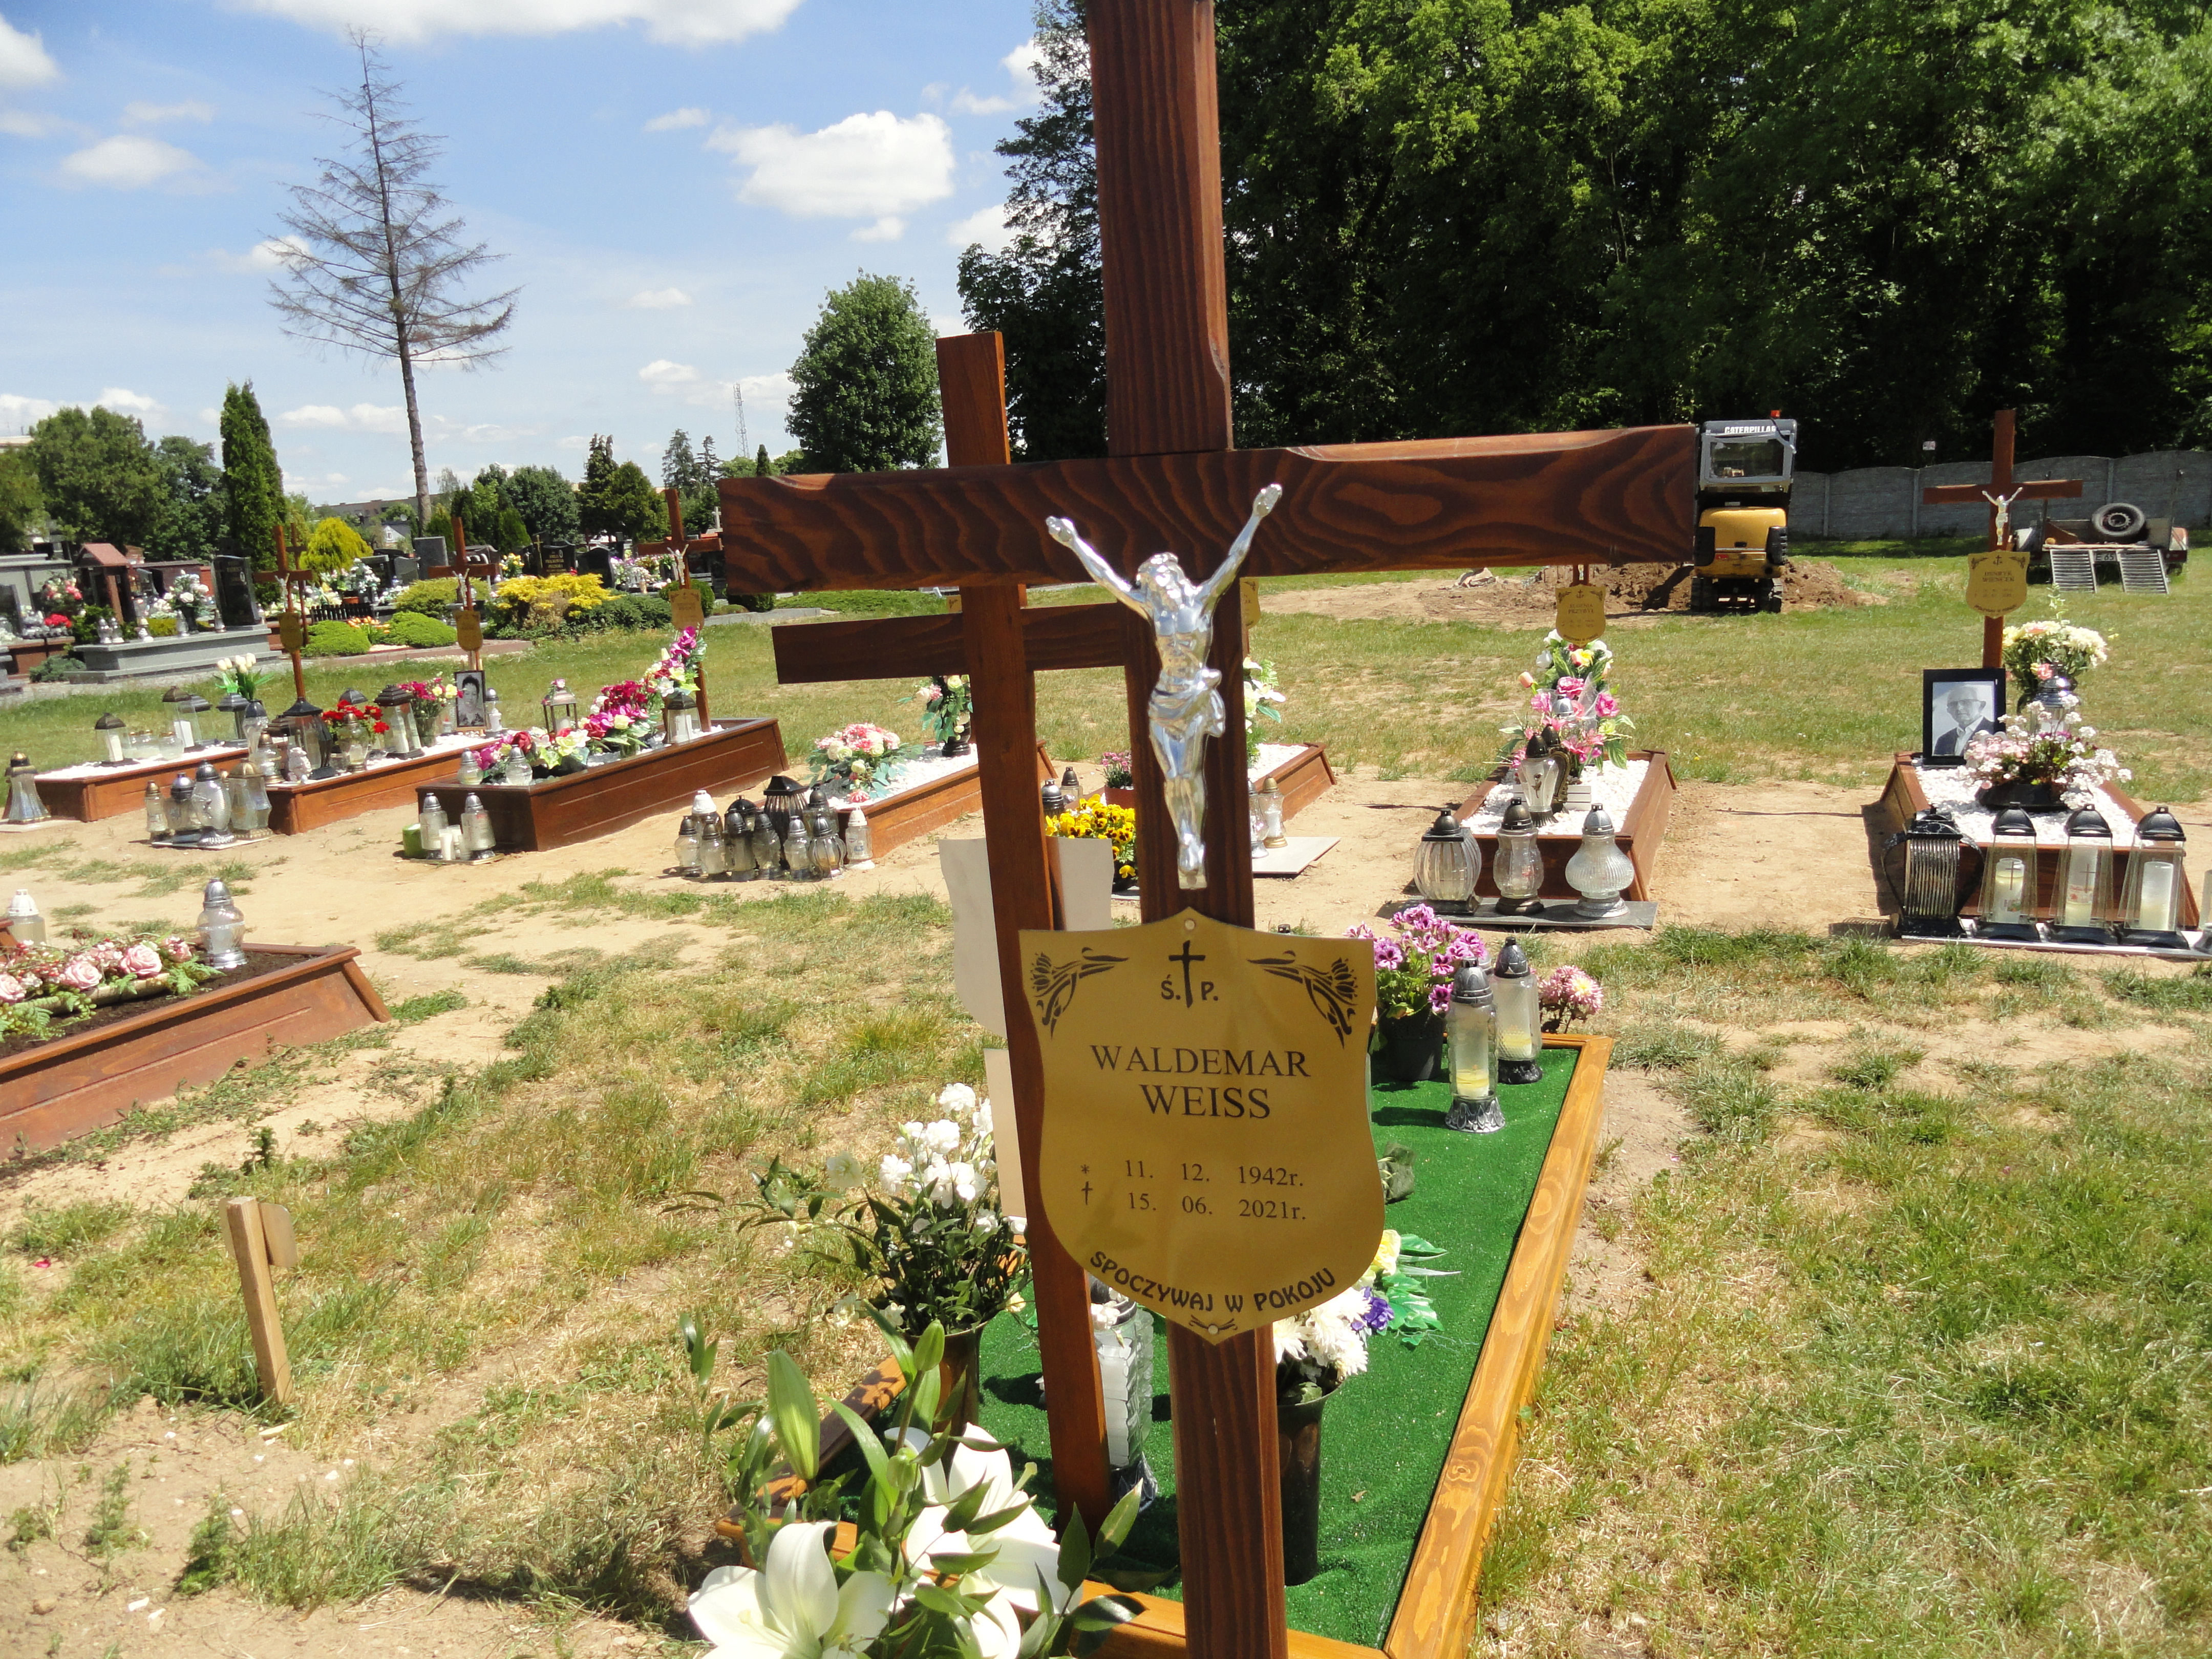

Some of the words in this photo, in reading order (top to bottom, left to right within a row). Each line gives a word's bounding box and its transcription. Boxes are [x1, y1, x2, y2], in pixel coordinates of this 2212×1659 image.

[1725, 426, 1776, 434] CATERPILLAR
[1090, 1045, 1311, 1077] WALDEMAR
[1138, 1084, 1270, 1119] WEISS
[1125, 1160, 1154, 1178] 11.
[1182, 1163, 1210, 1181] 12.
[1239, 1165, 1304, 1187] 1942r.
[1129, 1193, 1157, 1211] 15.
[1182, 1196, 1213, 1215] 06.
[1239, 1199, 1307, 1220] 2021r.
[1090, 1251, 1213, 1311] SPOCZYWAJ
[1224, 1294, 1243, 1313] W
[1253, 1267, 1335, 1311] POKOJU
